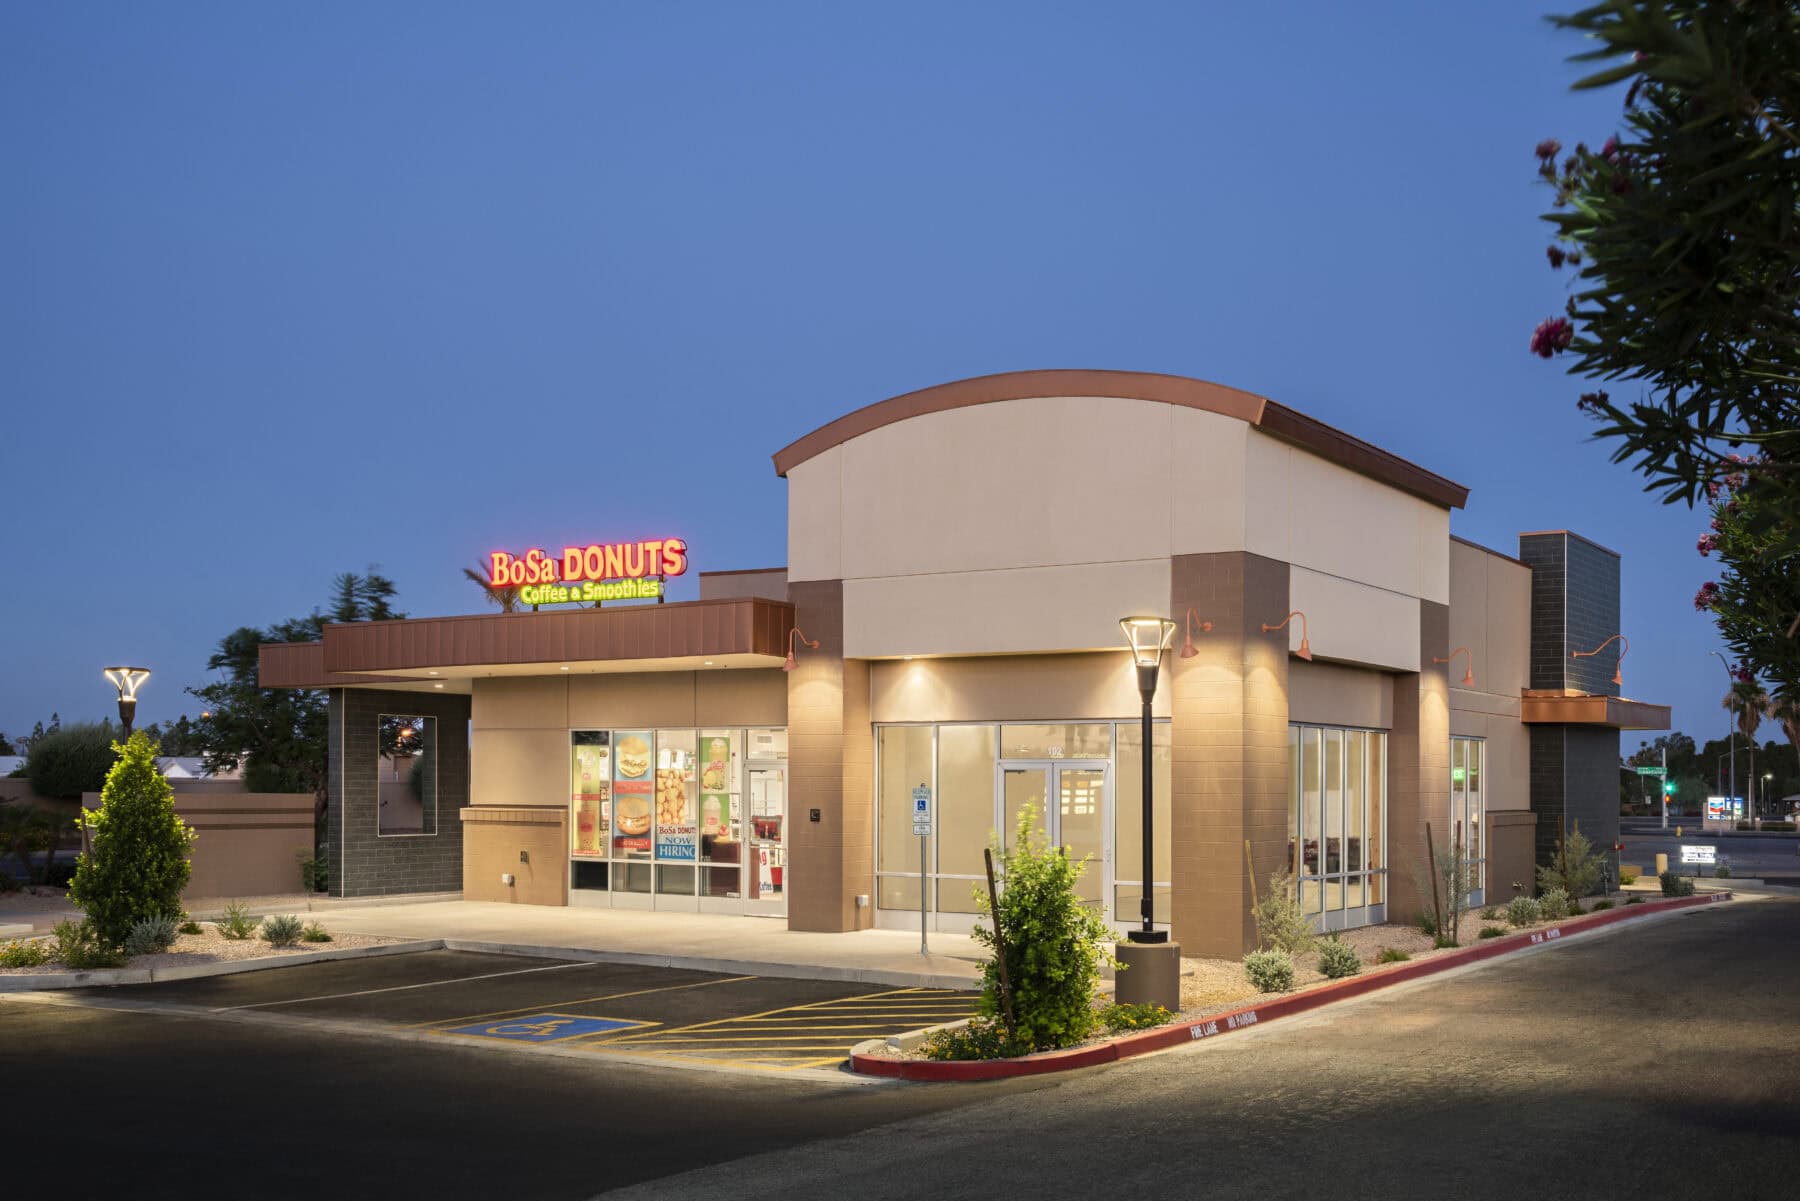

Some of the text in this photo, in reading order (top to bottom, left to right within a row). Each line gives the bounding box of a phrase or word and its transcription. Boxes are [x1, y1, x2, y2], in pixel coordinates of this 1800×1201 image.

[490, 538, 686, 586] BoSa DONUTS
[520, 577, 660, 604] Coffee & Smoothies
[665, 836, 691, 844] NOW
